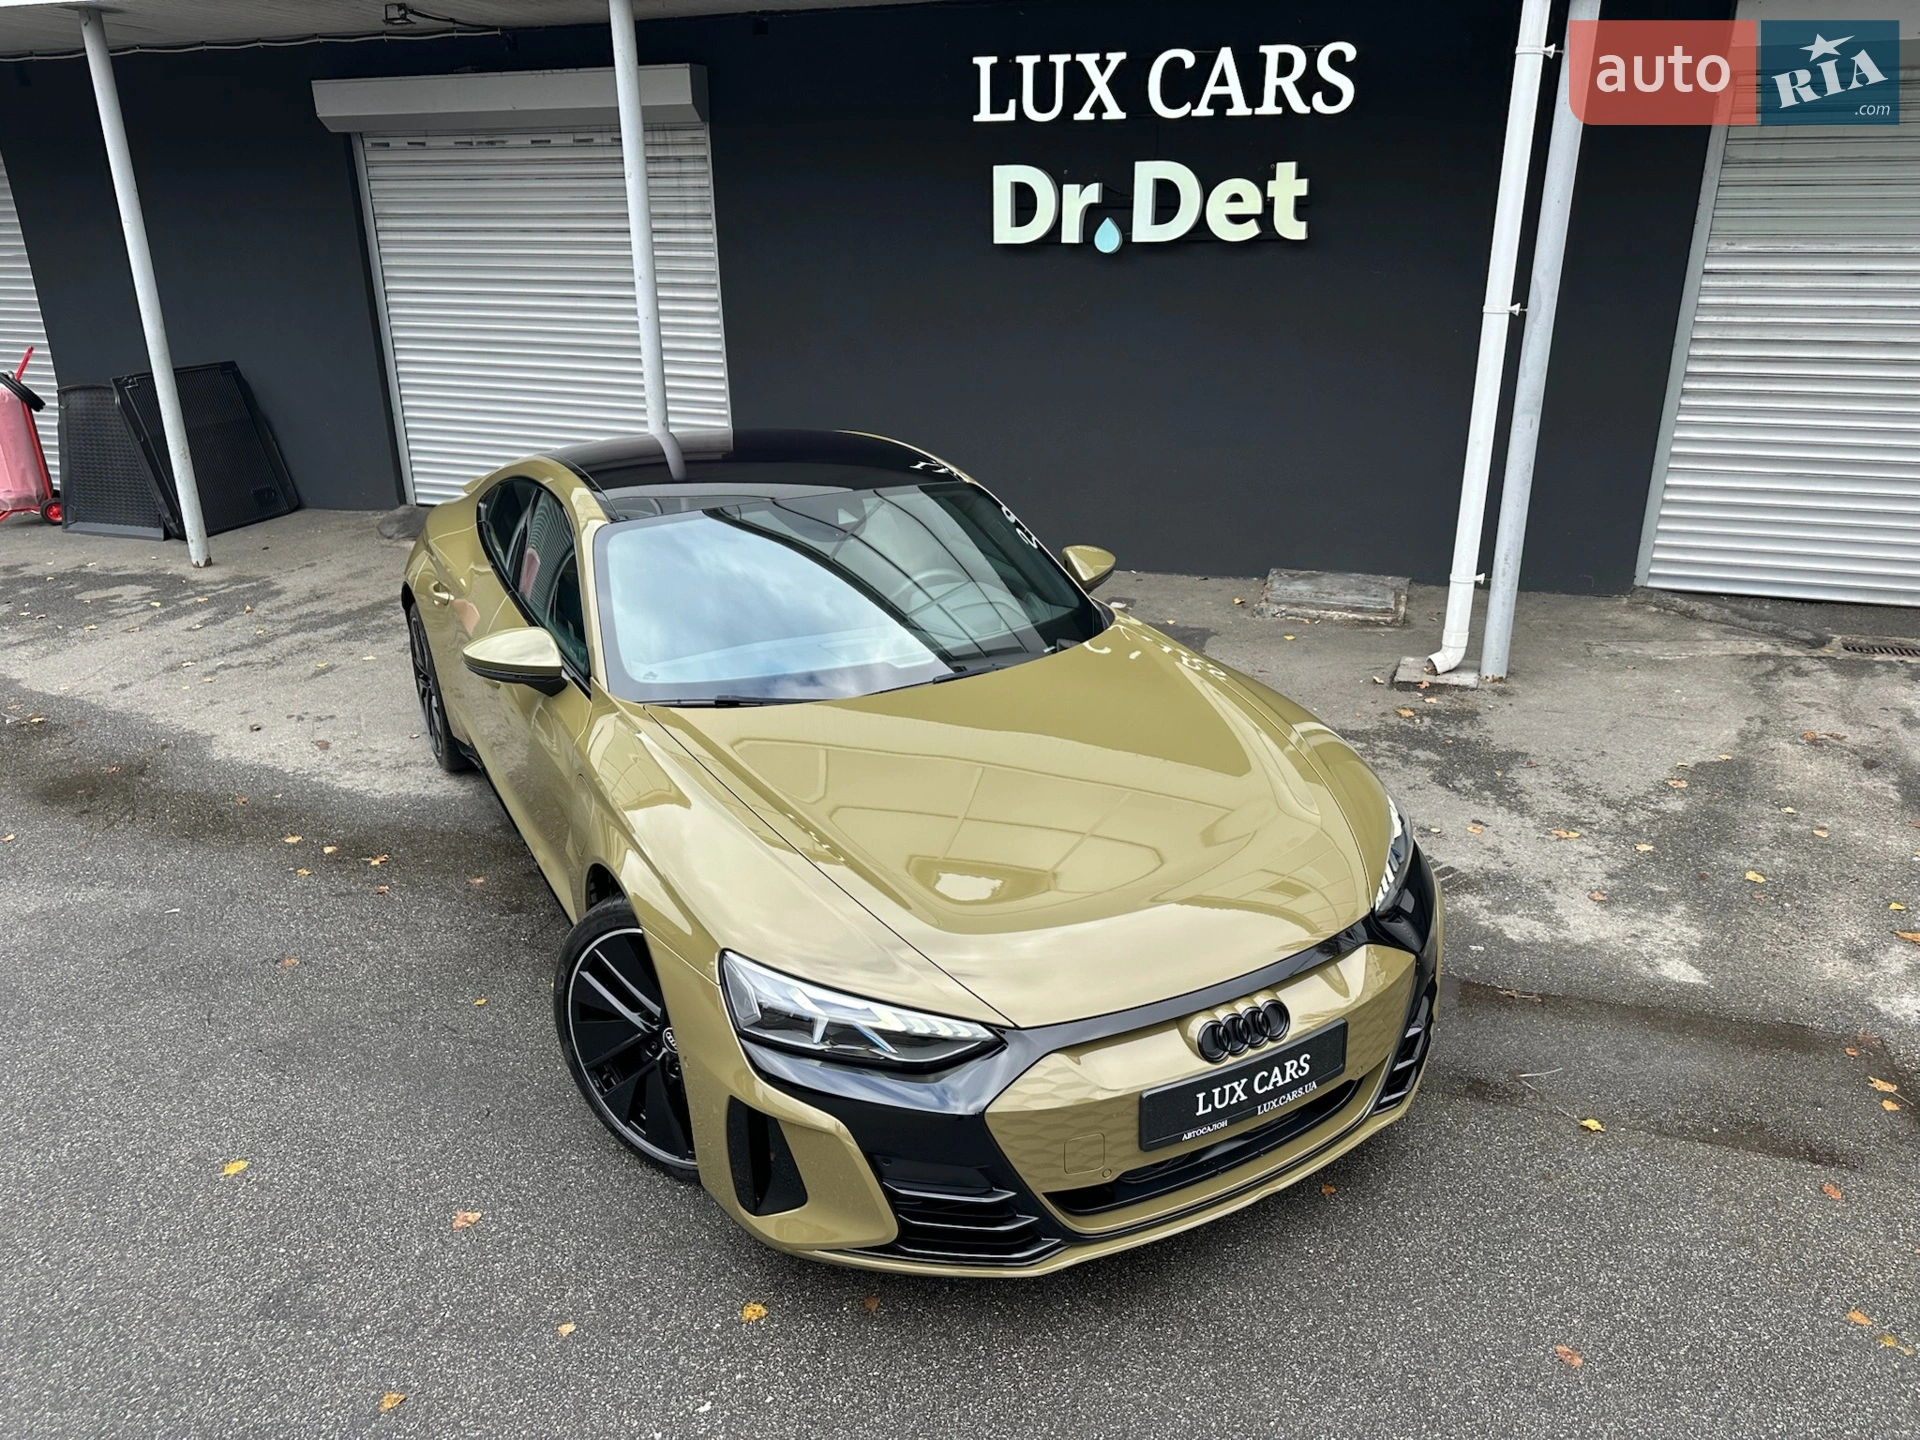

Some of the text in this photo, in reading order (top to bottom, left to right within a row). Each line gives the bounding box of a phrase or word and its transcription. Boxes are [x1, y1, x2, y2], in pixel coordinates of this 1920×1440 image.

[972, 41, 1357, 122] LUX CARS
[1195, 1053, 1311, 1116] LUX CARS
[1182, 1119, 1228, 1141] АВТОСАЛОН
